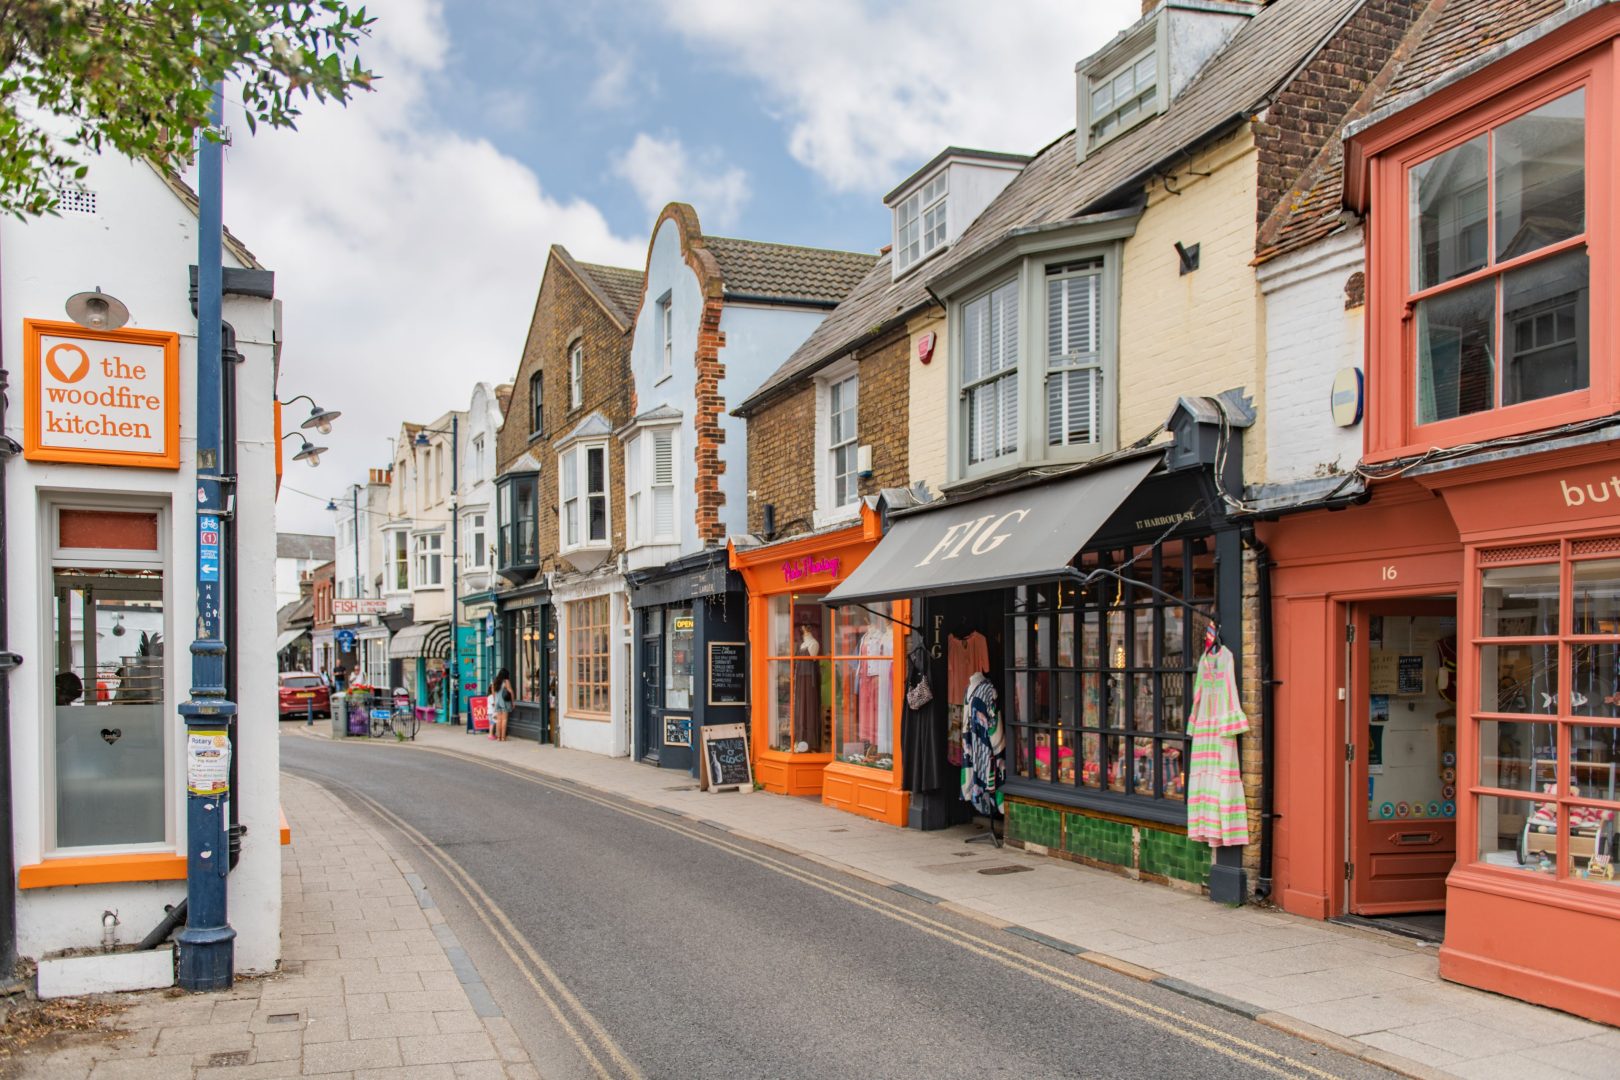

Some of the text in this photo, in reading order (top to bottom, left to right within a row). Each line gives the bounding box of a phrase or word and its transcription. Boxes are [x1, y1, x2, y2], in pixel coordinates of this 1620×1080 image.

[100, 356, 147, 380] the
[45, 386, 161, 411] woodfire
[45, 410, 152, 439] kitchen
[1143, 513, 1182, 528] HARBOUR
[914, 507, 1032, 568] FIG
[1382, 565, 1398, 581] 16
[334, 600, 358, 613] FISH
[676, 619, 694, 628] OPEN
[931, 615, 944, 659] FIG
[191, 737, 212, 745] Rotary
[716, 740, 743, 750] WINE
[720, 753, 745, 764] CLOCK
